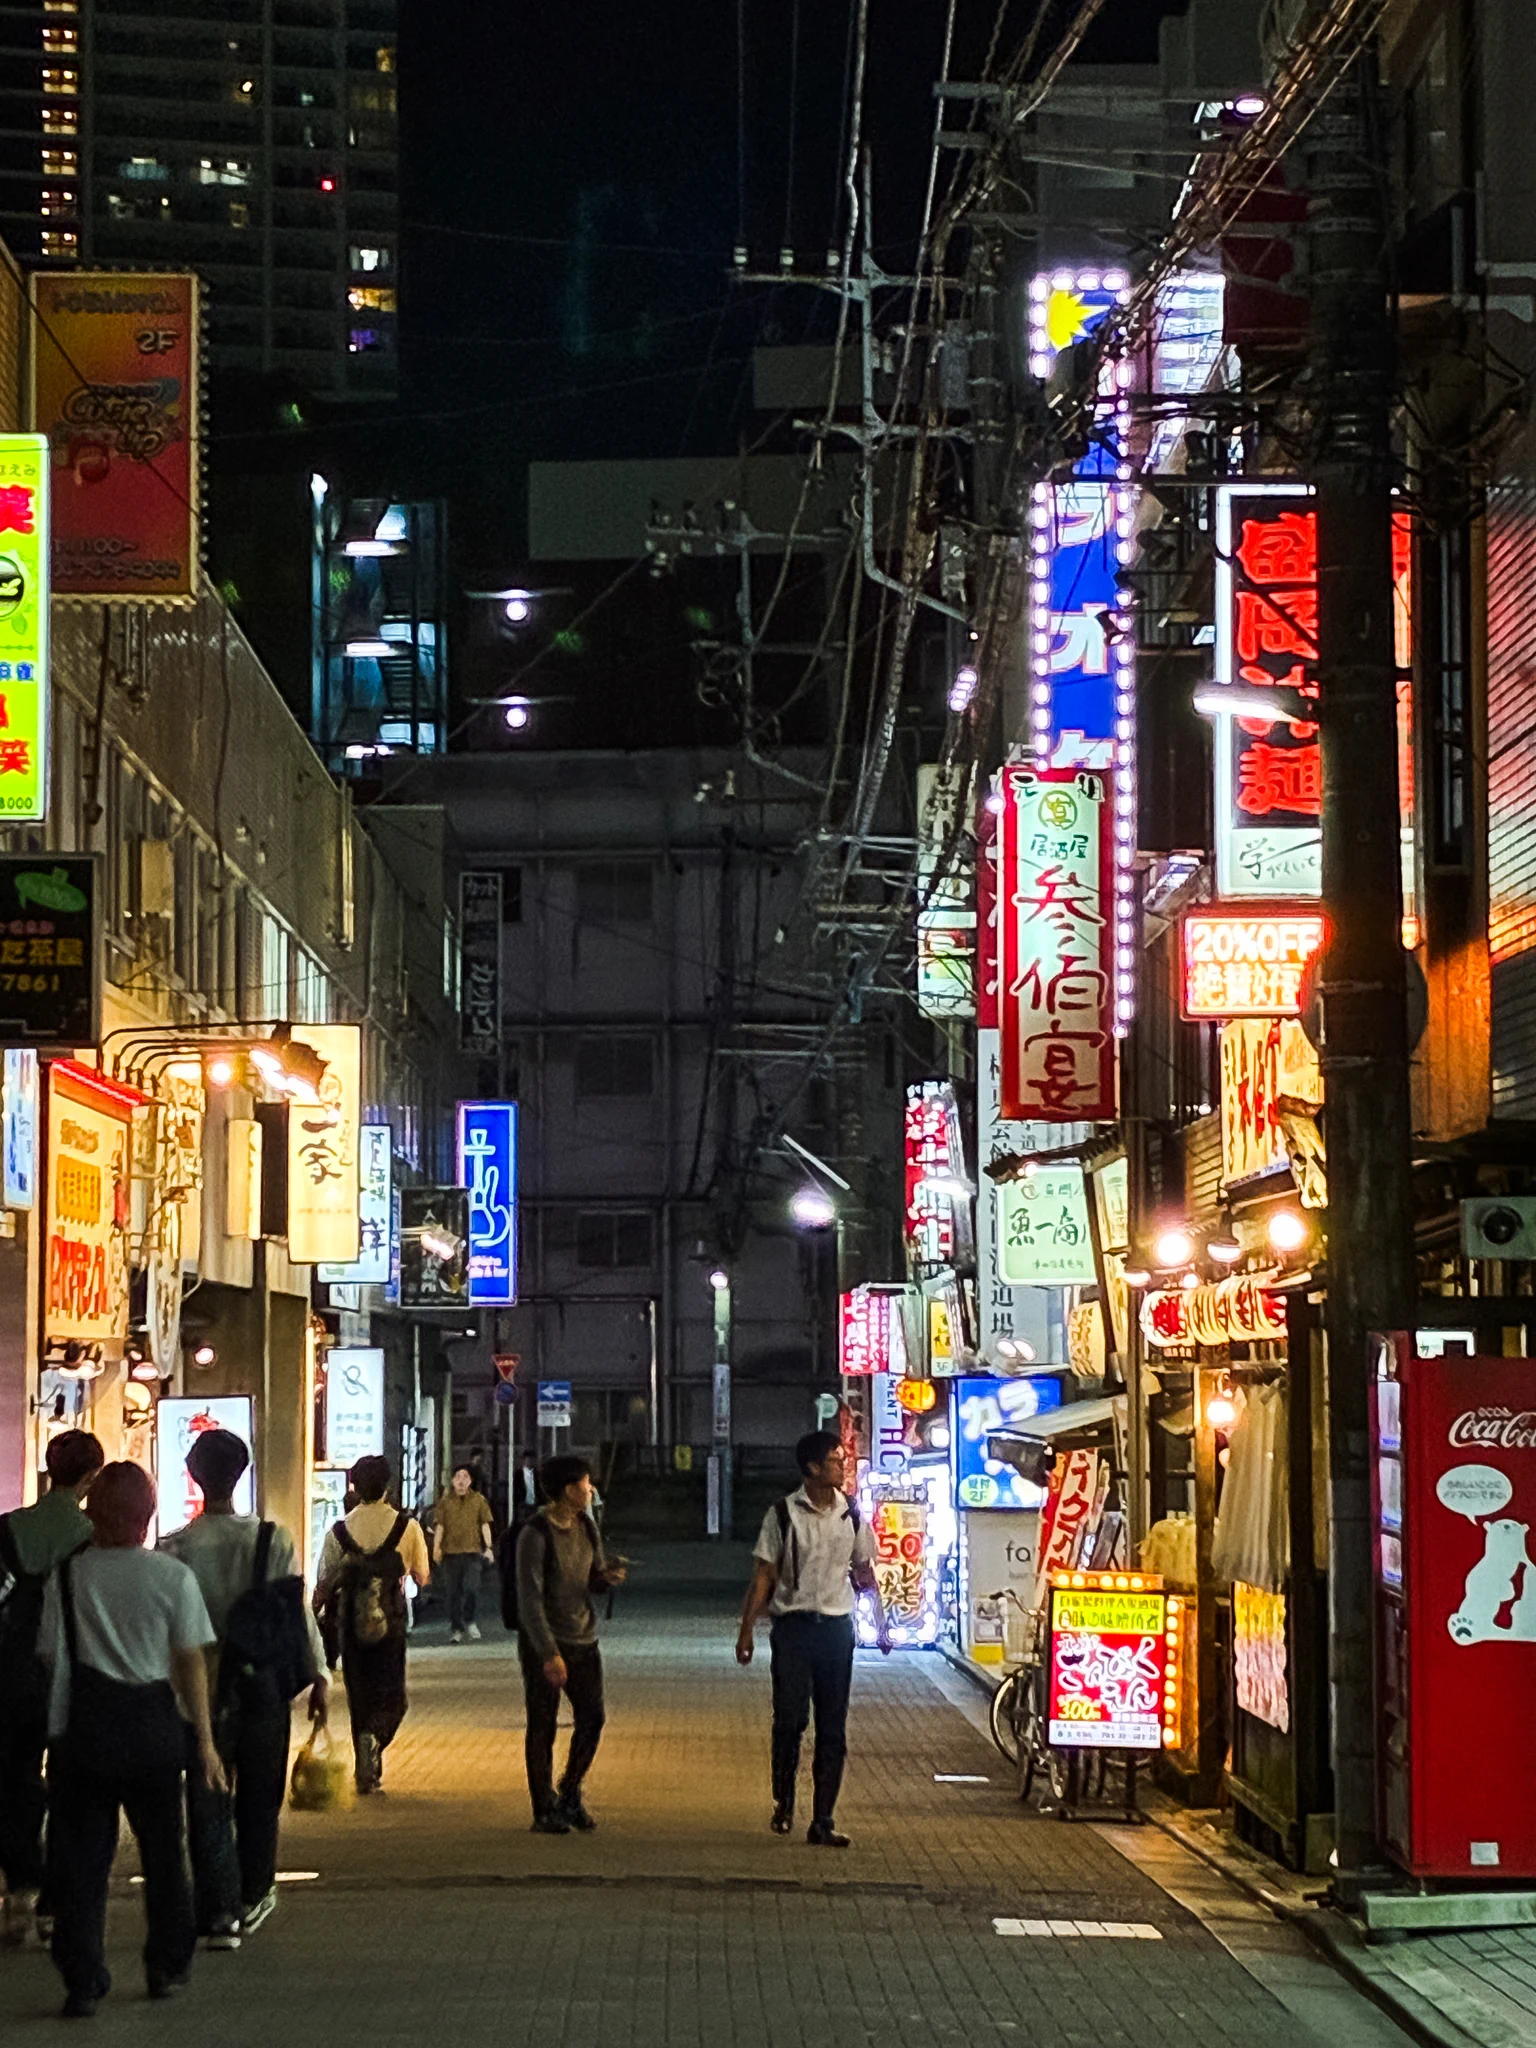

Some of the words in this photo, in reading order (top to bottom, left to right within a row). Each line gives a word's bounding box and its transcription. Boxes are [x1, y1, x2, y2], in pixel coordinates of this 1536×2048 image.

[1030, 834, 1089, 860] 居酒屋
[1193, 923, 1320, 961] 20%OFF
